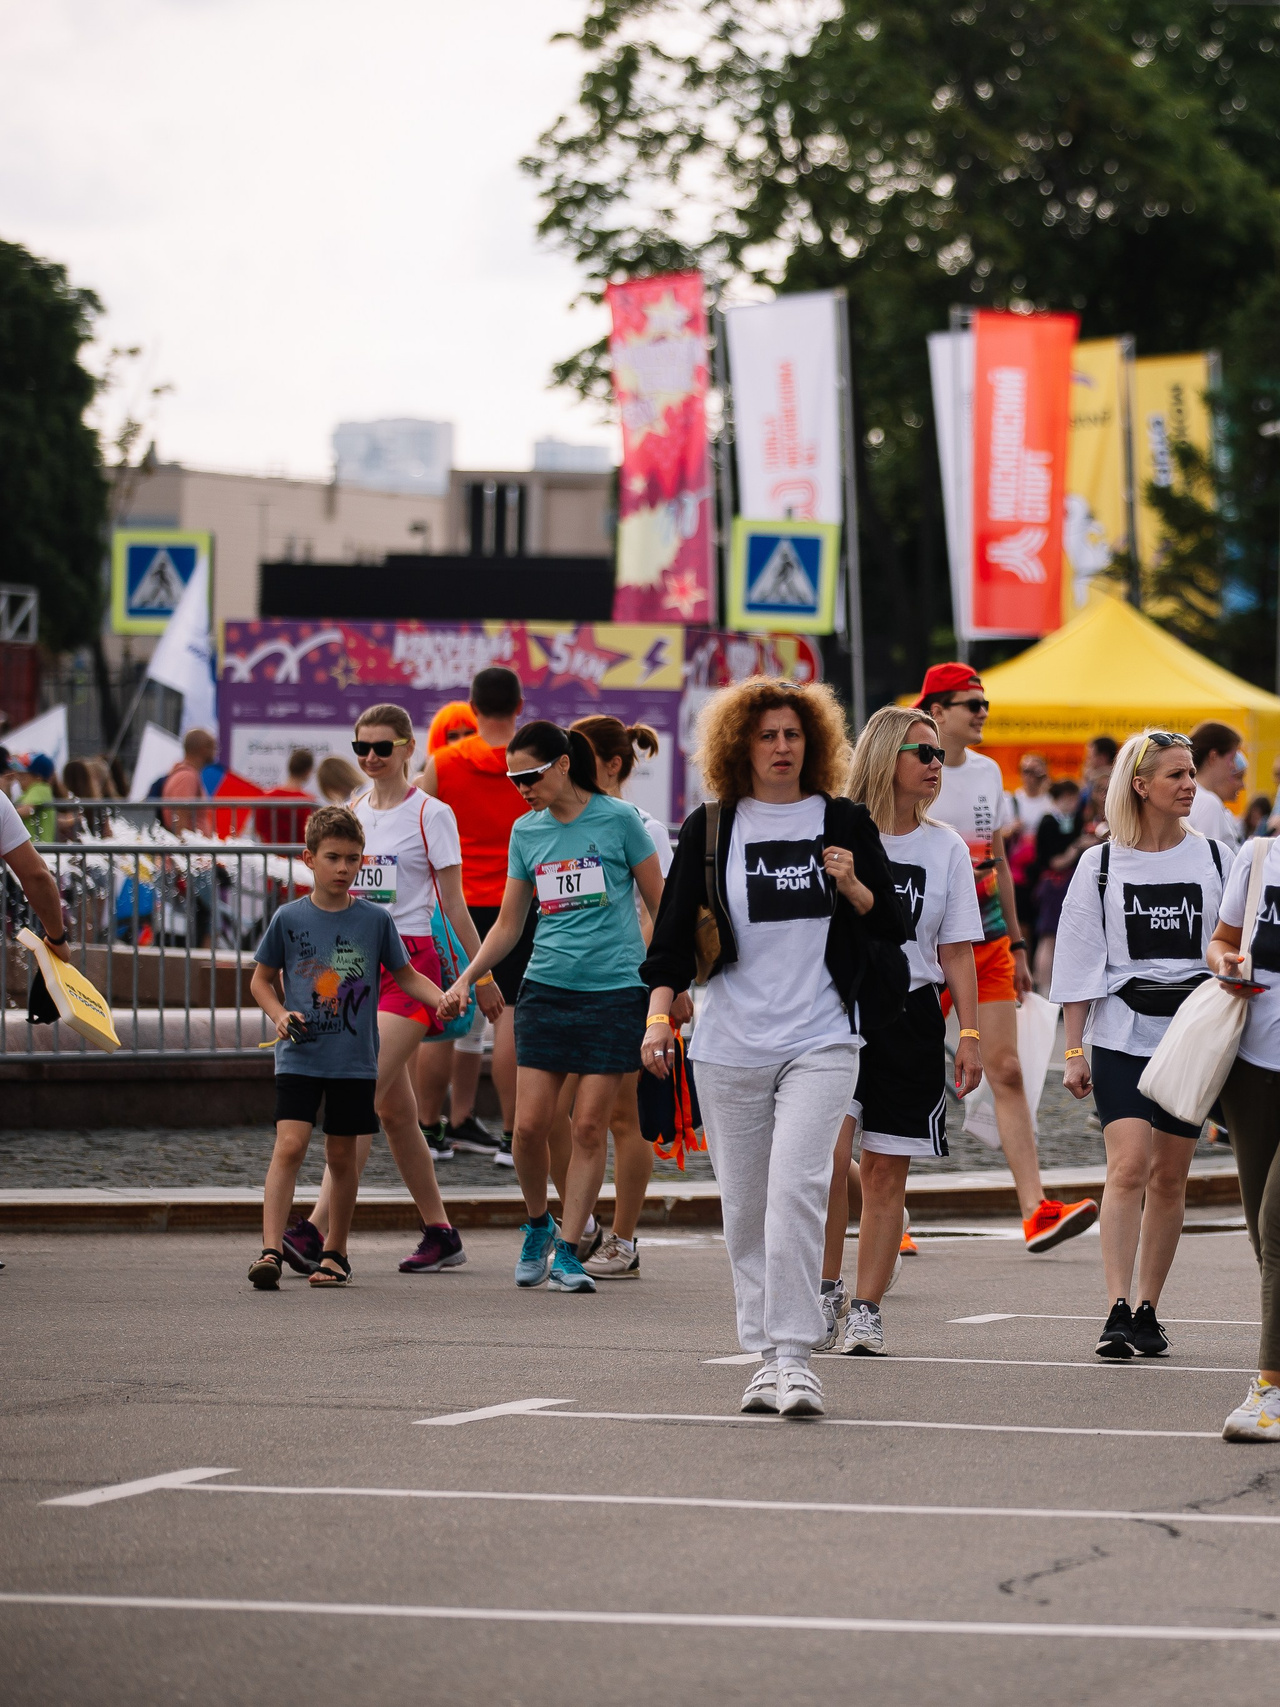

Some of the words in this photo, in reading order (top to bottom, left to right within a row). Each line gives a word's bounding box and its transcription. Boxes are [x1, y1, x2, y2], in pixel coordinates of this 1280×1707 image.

[556, 873, 582, 895] 787
[776, 876, 812, 891] RUN
[1150, 917, 1180, 930] RUN
